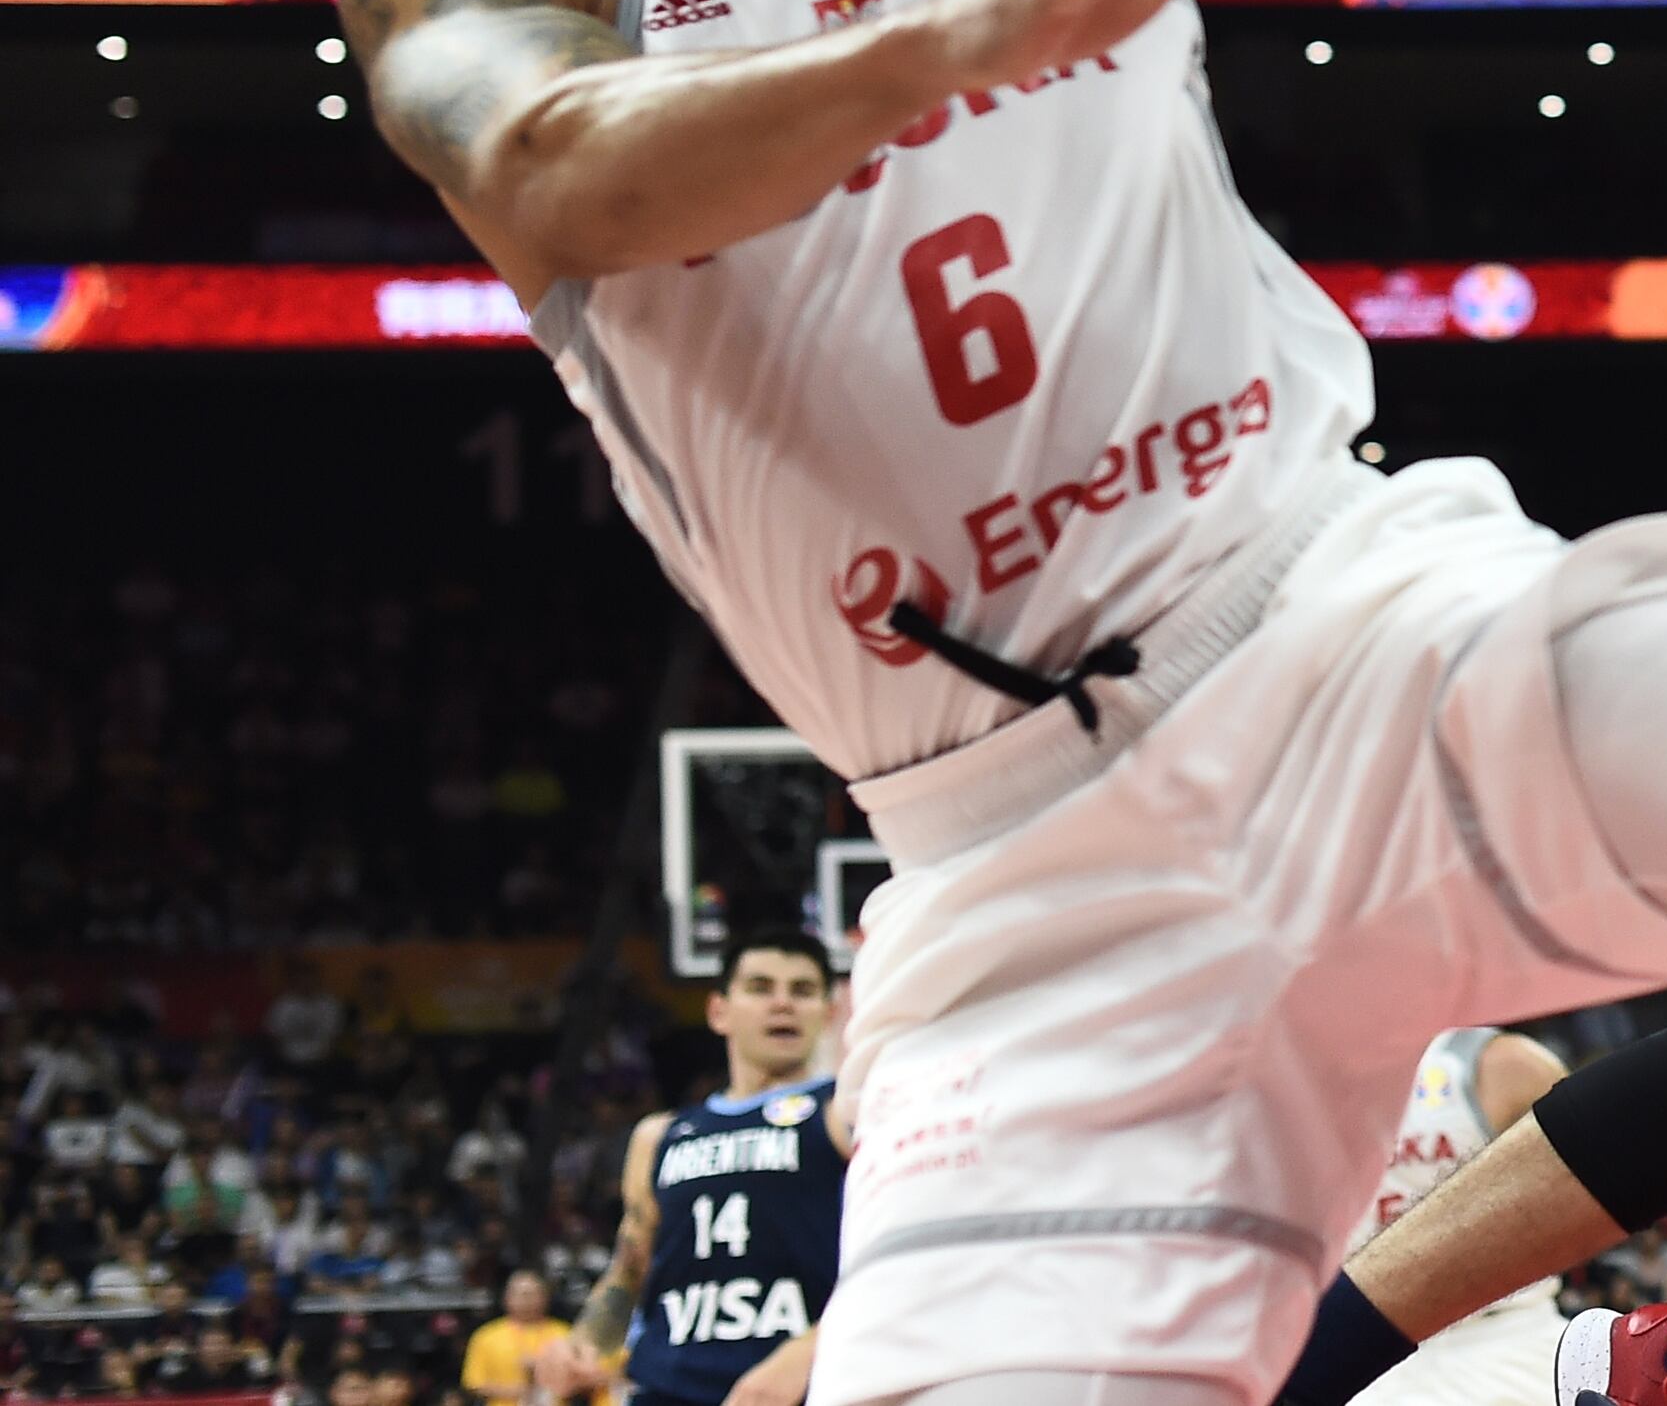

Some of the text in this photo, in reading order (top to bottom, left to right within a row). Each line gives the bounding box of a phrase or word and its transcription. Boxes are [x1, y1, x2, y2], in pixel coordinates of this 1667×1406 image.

[901, 213, 1040, 429] 6
[962, 376, 1272, 595] Energa
[692, 1192, 751, 1260] 14
[661, 1278, 811, 1346] VISA
